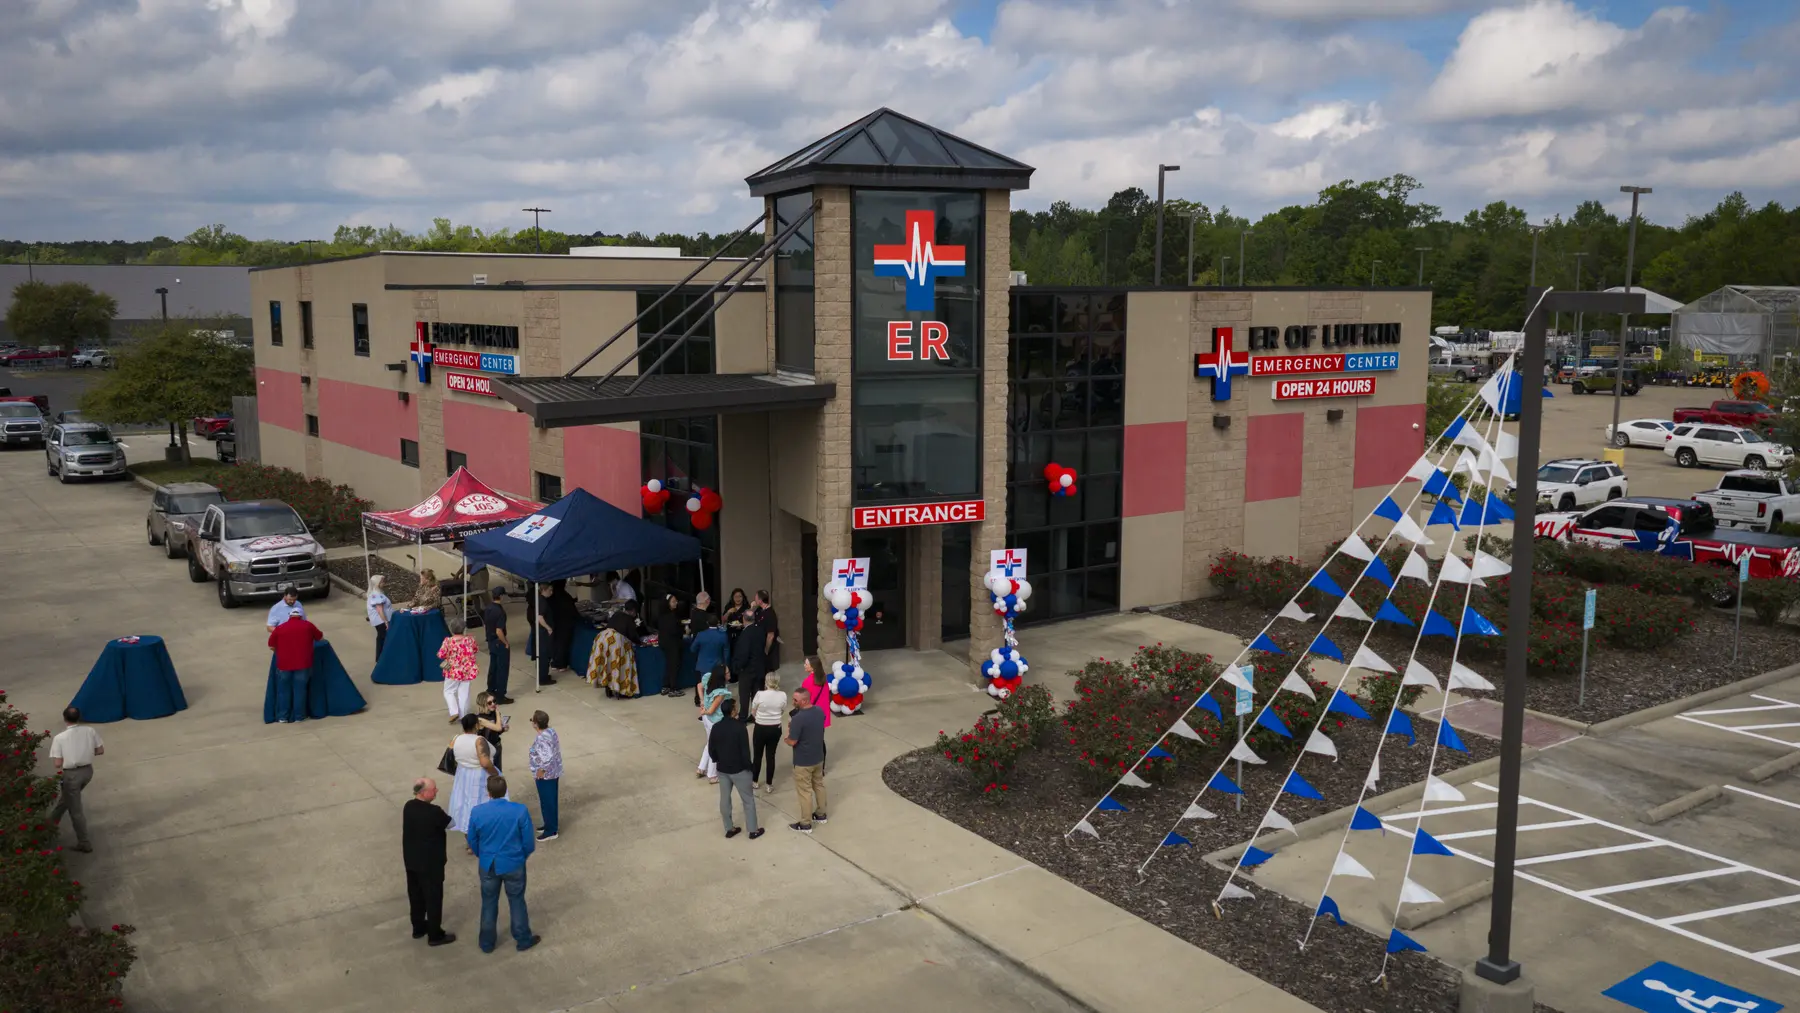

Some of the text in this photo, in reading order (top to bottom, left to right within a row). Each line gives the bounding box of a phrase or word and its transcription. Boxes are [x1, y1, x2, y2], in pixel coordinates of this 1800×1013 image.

[887, 320, 950, 361] ER
[1249, 323, 1402, 350] ER OF LUFKIN
[434, 351, 513, 371] EMERGENCY CENTER
[1255, 355, 1396, 372] EMERGENCY CENTER
[449, 375, 492, 394] OPEN 24 HOU
[1281, 379, 1371, 397] OPEN 24 HOURS
[473, 502, 494, 511] 105
[862, 504, 977, 526] ENTRANCE
